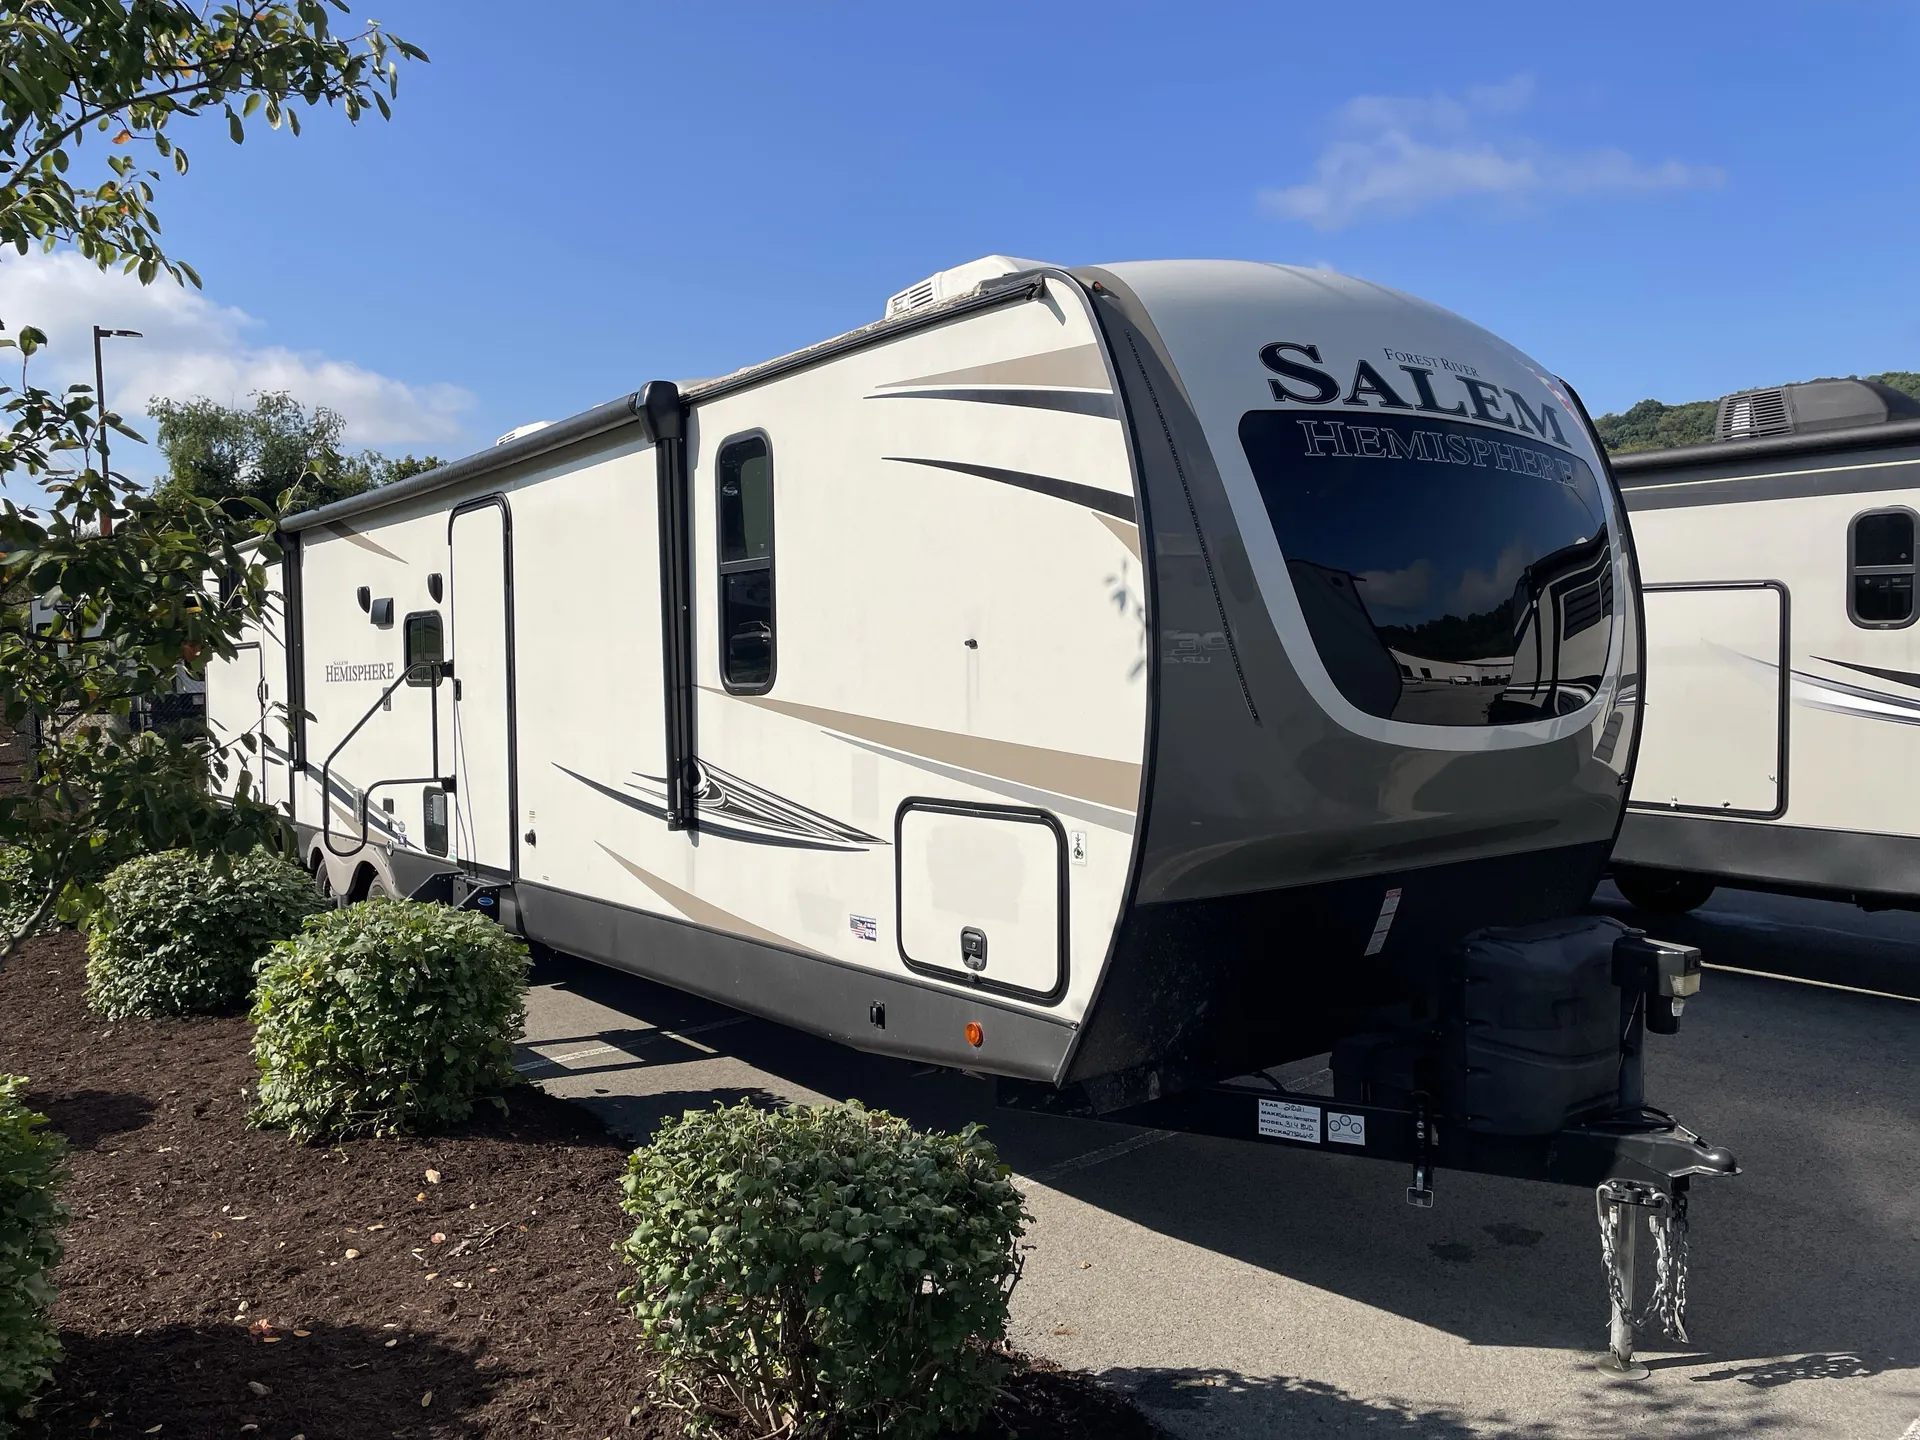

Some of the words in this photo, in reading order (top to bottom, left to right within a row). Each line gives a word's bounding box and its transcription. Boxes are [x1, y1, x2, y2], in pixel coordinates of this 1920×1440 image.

[1383, 347, 1438, 368] FOREST
[1440, 357, 1480, 377] RIVER
[1258, 341, 1573, 448] SALEM
[1297, 419, 1578, 489] HEMISPHERE
[325, 662, 394, 682] HEMISPHERE
[1260, 1101, 1279, 1109] YEAR
[1260, 1110, 1281, 1118] MAKE
[1260, 1118, 1284, 1127] MODEL
